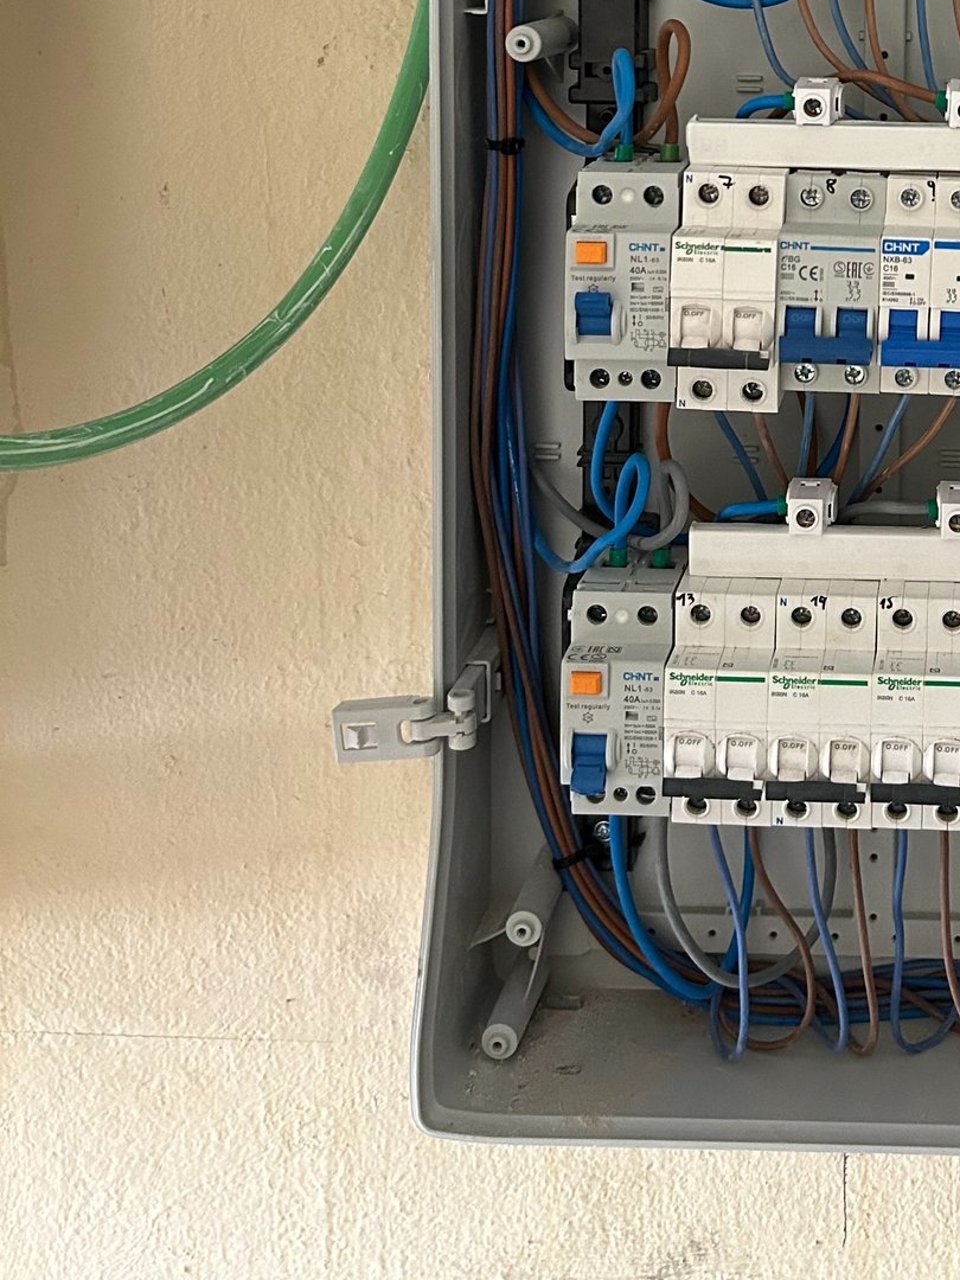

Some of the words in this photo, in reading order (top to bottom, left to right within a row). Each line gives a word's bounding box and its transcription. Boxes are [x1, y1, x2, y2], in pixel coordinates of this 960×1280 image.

[685, 175, 693, 183] N
[825, 178, 837, 194] 8
[675, 241, 719, 255] Schneider
[882, 256, 912, 264] NXB-63
[678, 399, 686, 407] N
[676, 593, 695, 606] 13
[779, 598, 787, 606] N
[879, 595, 898, 609] 15
[669, 671, 714, 686] Schneider
[772, 675, 817, 689] Schneider
[877, 677, 922, 690] Schneider
[581, 703, 610, 711] regularly
[776, 817, 784, 825] N
